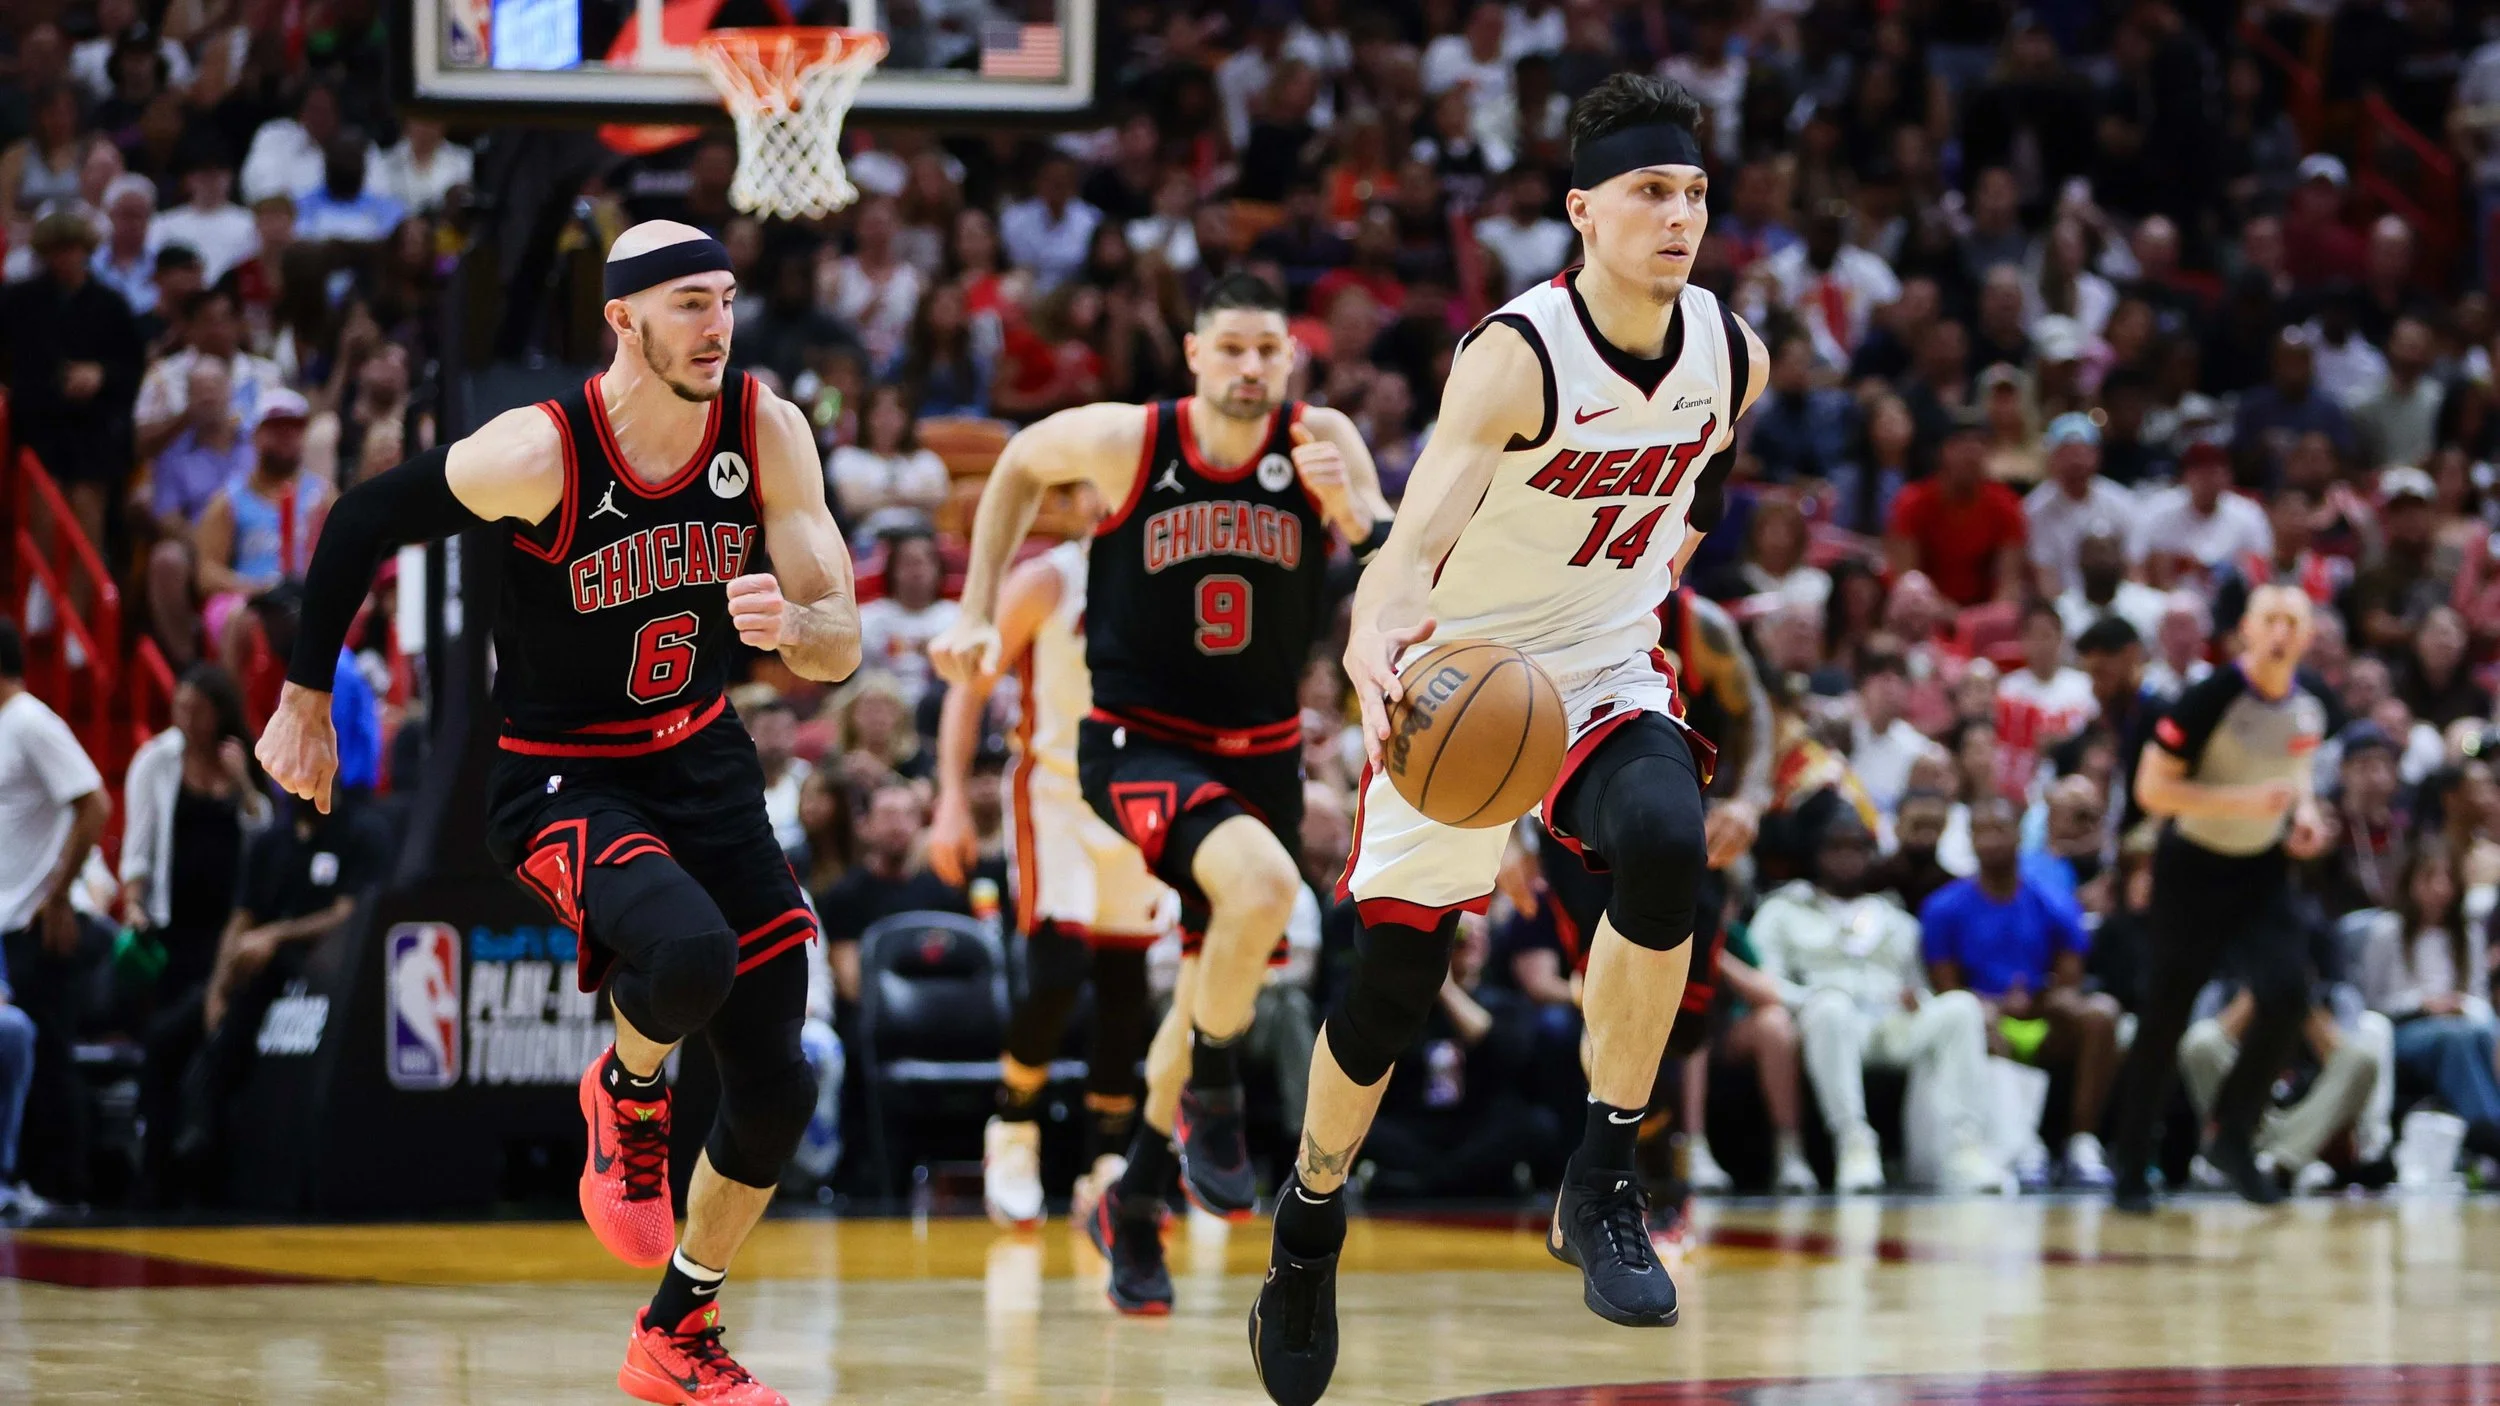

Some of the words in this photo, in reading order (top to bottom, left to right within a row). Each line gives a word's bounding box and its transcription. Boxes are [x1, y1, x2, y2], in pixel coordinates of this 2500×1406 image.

[1680, 396, 1712, 409] Carnival
[1525, 412, 1717, 500] HEAT
[1144, 500, 1302, 575] CHICAGO
[1567, 503, 1671, 569] 14
[1195, 574, 1253, 657] 9
[627, 610, 699, 705] 6
